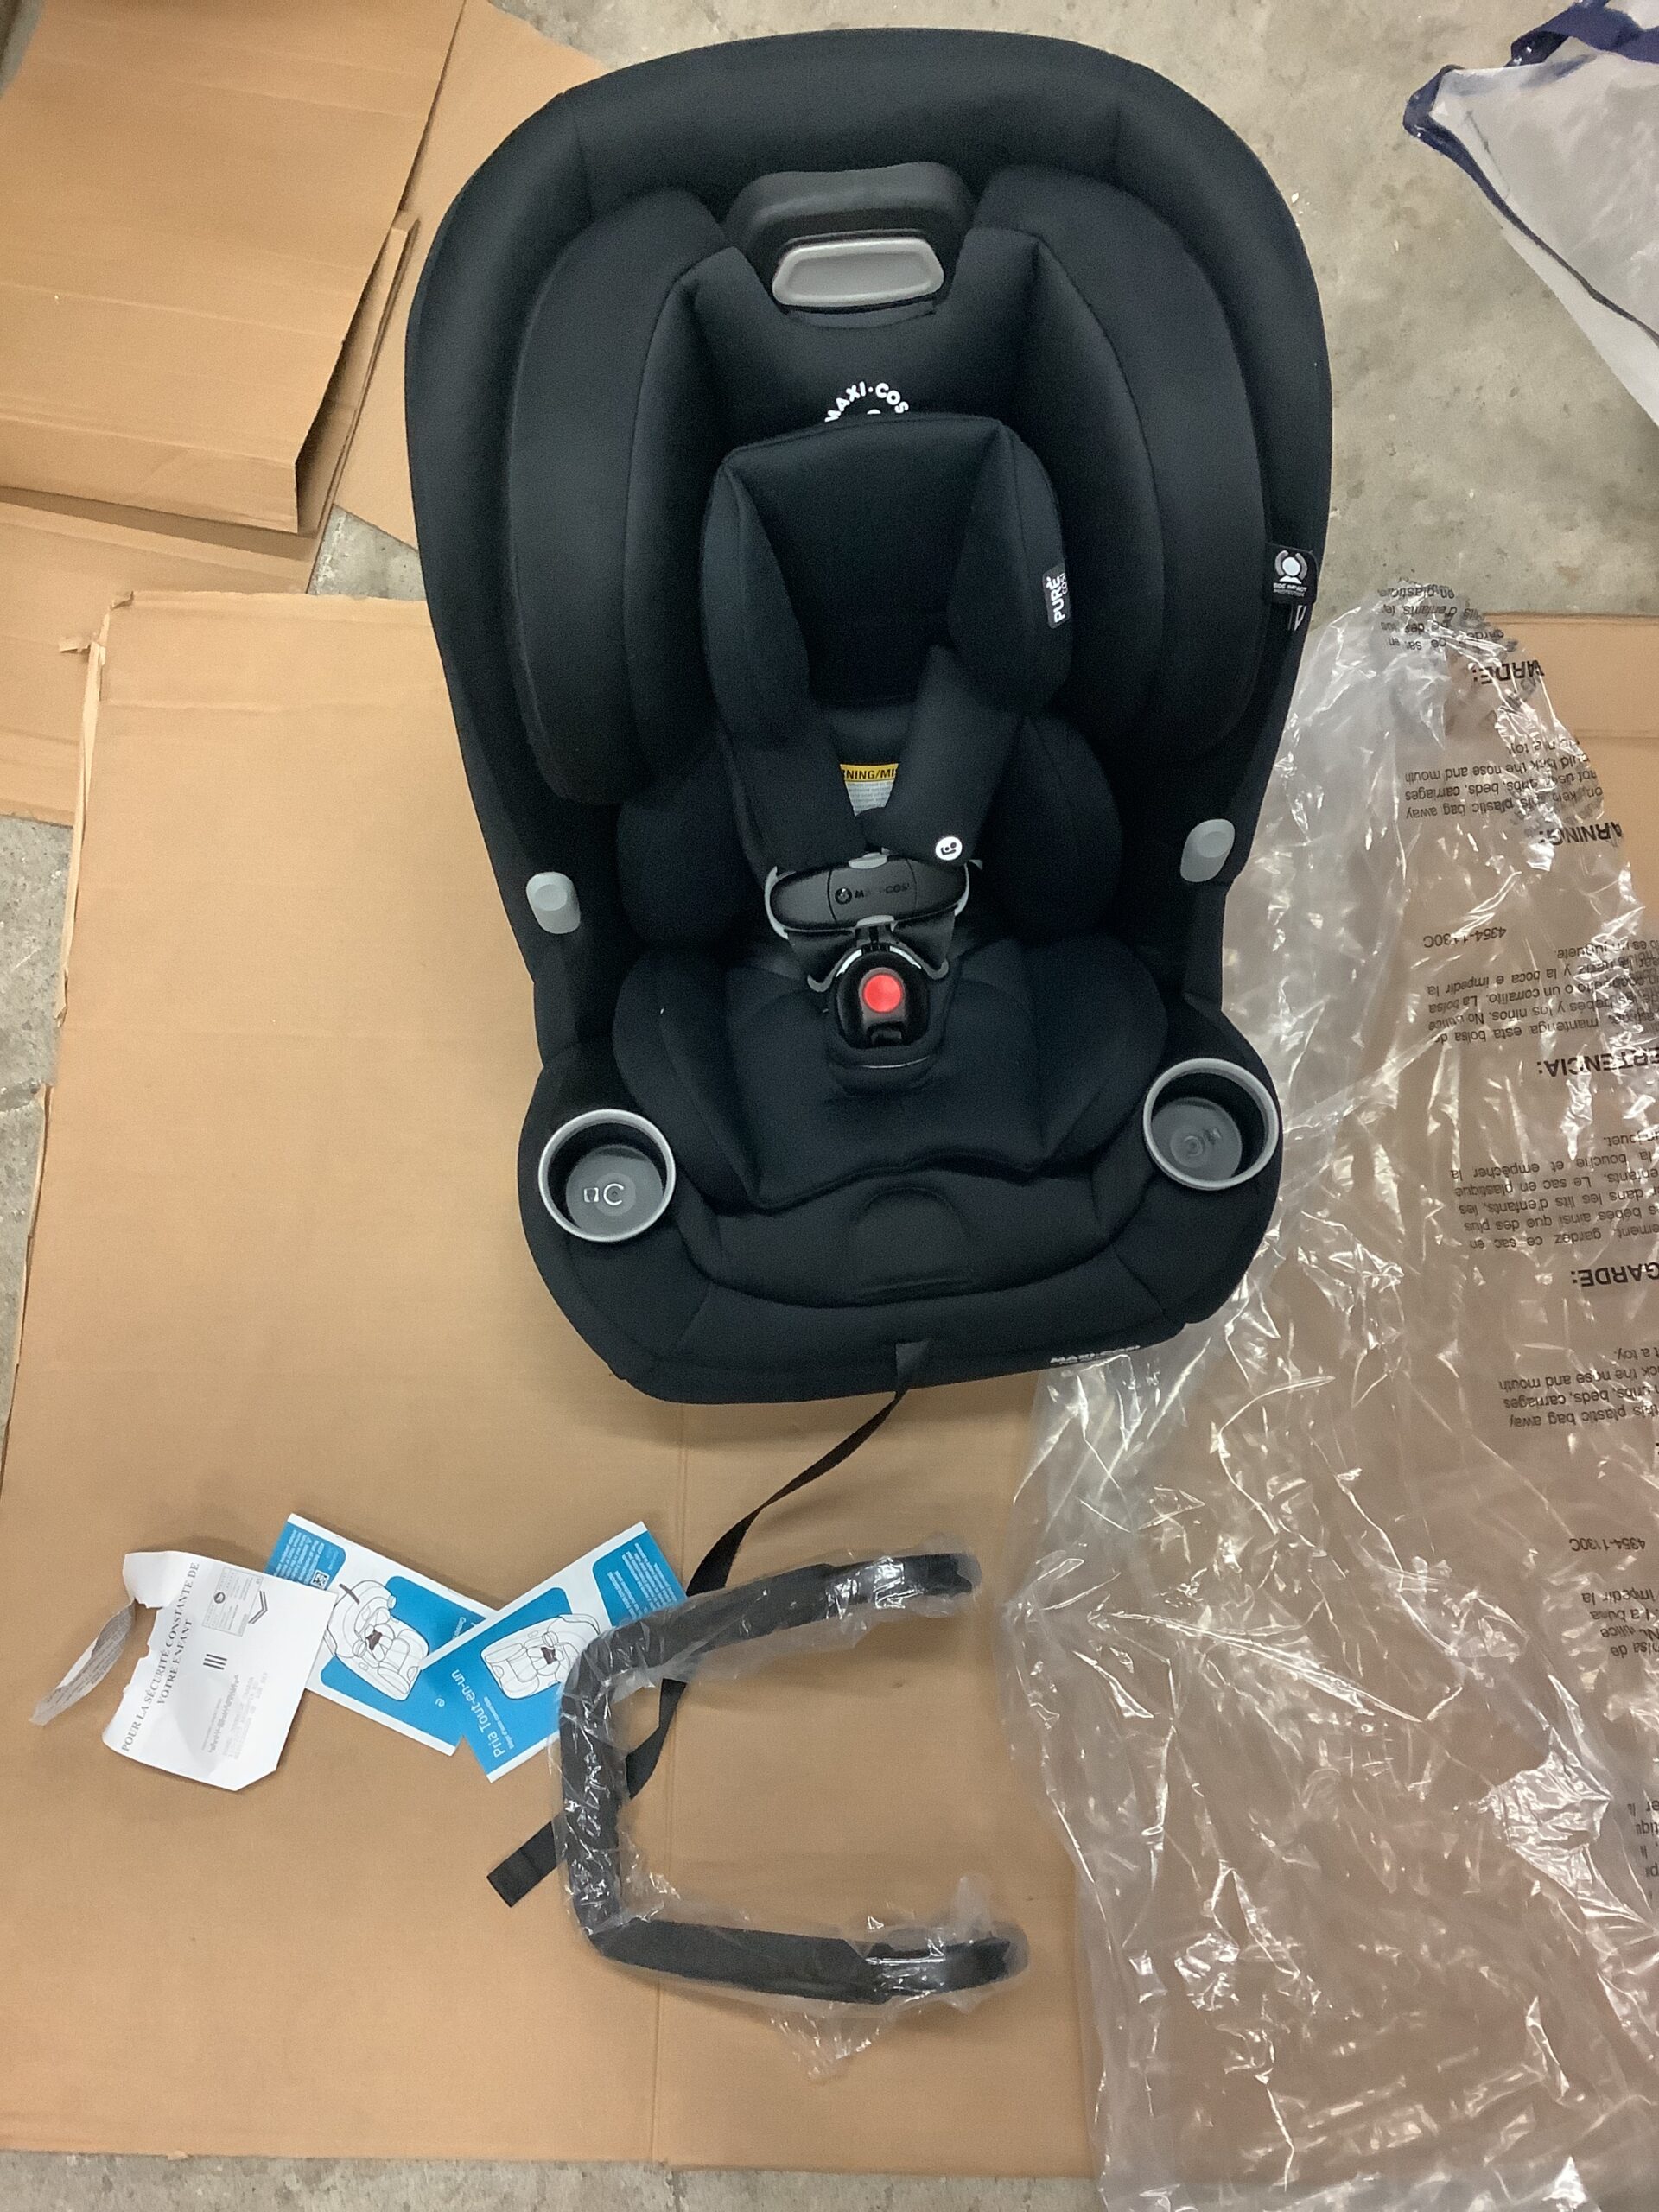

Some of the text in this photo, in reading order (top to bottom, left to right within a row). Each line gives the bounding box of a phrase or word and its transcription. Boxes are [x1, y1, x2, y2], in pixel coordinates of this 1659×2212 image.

[1405, 770, 1440, 783] mouth
[1445, 767, 1468, 780] and
[1472, 766, 1502, 778] nose
[1405, 786, 1460, 802] carriages
[1464, 783, 1498, 796] beds,
[1443, 804, 1465, 817] bag
[1471, 798, 1513, 814] plastic
[1406, 805, 1438, 821] away
[1545, 968, 1557, 979] la
[1563, 964, 1571, 977] y
[1496, 976, 1504, 985] e
[1511, 971, 1541, 984] boca
[1427, 986, 1440, 997] la
[1446, 976, 1490, 995] impedir
[1543, 986, 1560, 997] un
[1565, 985, 1573, 994] o
[1461, 995, 1478, 1006] La
[1486, 988, 1540, 1002] corralito.
[1488, 1007, 1528, 1021] niños.
[1532, 1005, 1553, 1017] los
[1556, 1001, 1563, 1015] y
[1467, 1012, 1484, 1026] No
[1454, 1029, 1486, 1043] bolsa
[1493, 1027, 1522, 1039] esta
[1451, 1151, 1652, 1181] la bouche et empêcher la
[1520, 1181, 1536, 1192] en
[1542, 1179, 1567, 1191] sac
[1573, 1176, 1592, 1189] Le
[1455, 1181, 1513, 1198] plastique
[1555, 1196, 1574, 1209] lits
[1582, 1193, 1602, 1206] les
[1609, 1189, 1644, 1204] dans
[1459, 1205, 1478, 1217] les
[1495, 1219, 1520, 1232] des
[1526, 1216, 1552, 1230] que
[1559, 1212, 1591, 1226] ainsi
[1465, 1219, 1490, 1234] plus
[1527, 1236, 1543, 1248] ce
[1554, 1227, 1602, 1244] gardez
[1470, 1240, 1484, 1249] en
[1494, 1238, 1516, 1249] sac
[1614, 1348, 1638, 1361] toy.
[1641, 1348, 1650, 1358] a
[1576, 1371, 1611, 1383] nose
[1615, 1369, 1637, 1381] the
[1498, 1379, 1541, 1391] mouth
[1545, 1375, 1571, 1389] and
[1503, 1395, 1566, 1409] carriages
[1569, 1390, 1609, 1405] beds,
[1548, 1412, 1576, 1426] bag
[1580, 1405, 1627, 1422] plastic
[1510, 1414, 1541, 1427] away
[1581, 1592, 1595, 1605] la
[121, 1562, 200, 1752] POUR LA SÉCURITÉ CONSTANTE DE
[1610, 1645, 1628, 1658] de
[156, 1621, 192, 1705] VOTRE ENFANT
[451, 1669, 505, 1758] Pria Tout-en-un
